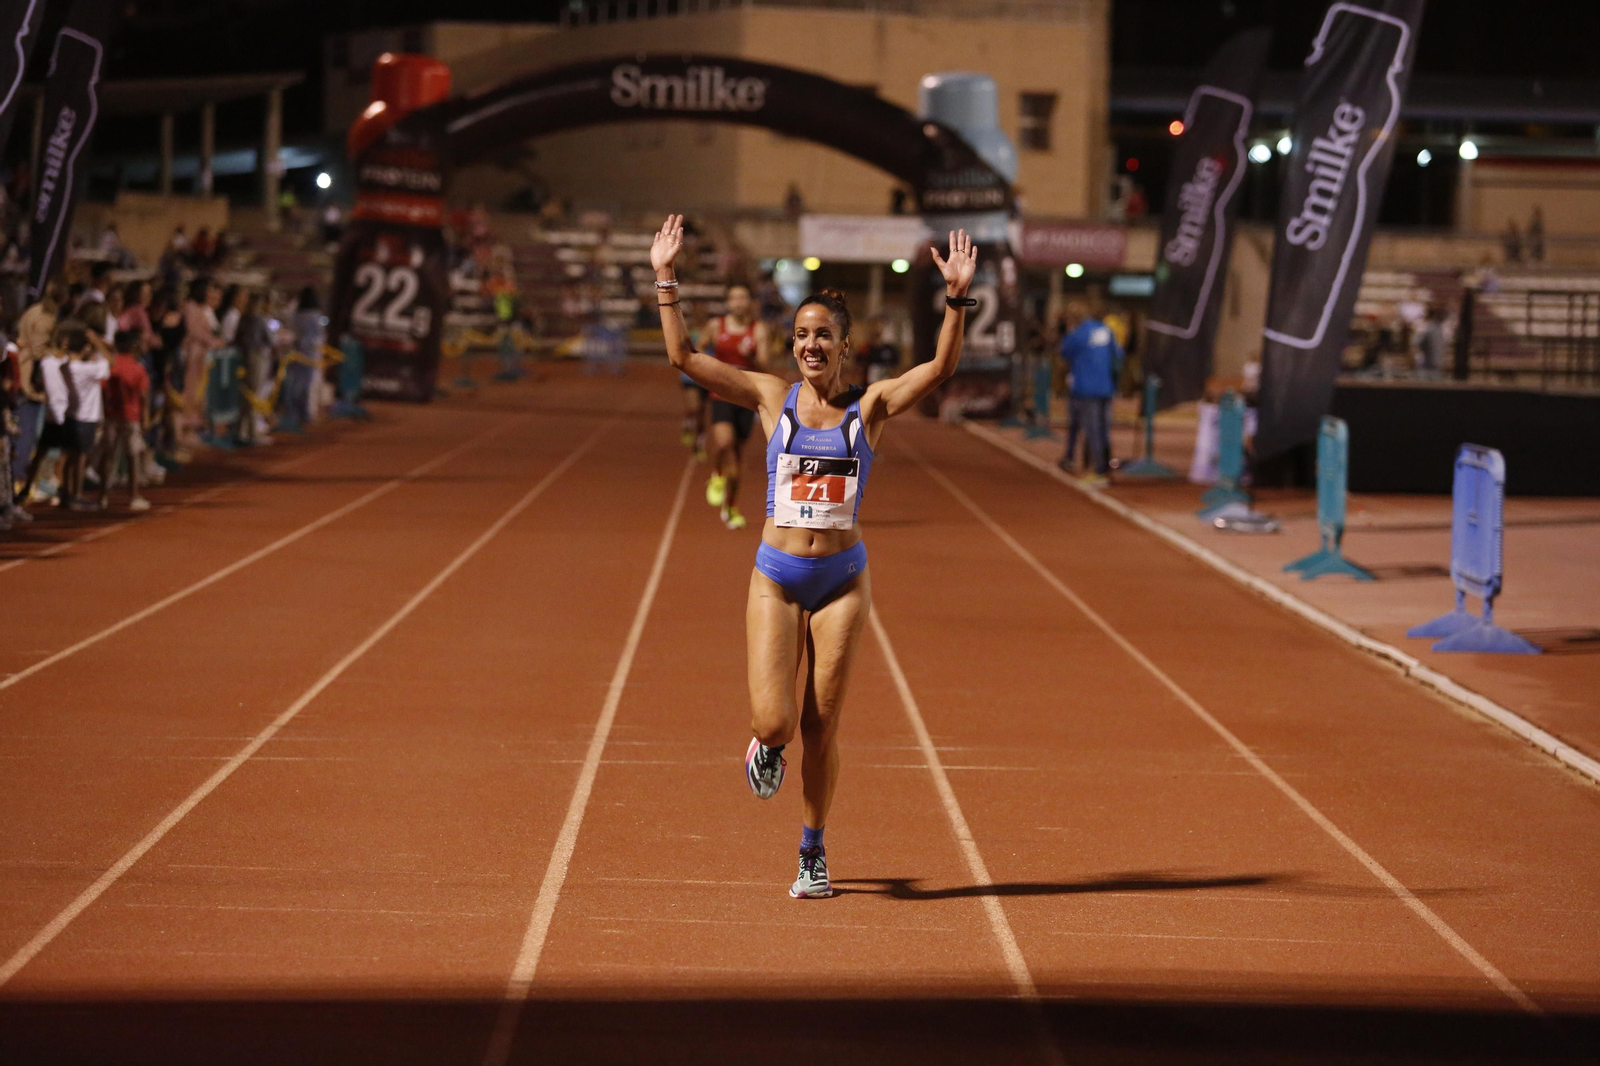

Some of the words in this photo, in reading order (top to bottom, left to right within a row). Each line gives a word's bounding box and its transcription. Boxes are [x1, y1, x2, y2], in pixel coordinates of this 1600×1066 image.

[610, 63, 767, 112] Smilke
[36, 105, 76, 223] Smilke
[1286, 100, 1366, 250] Smilke
[1164, 156, 1224, 267] Smilke
[803, 459, 819, 475] 21
[806, 483, 830, 501] 71
